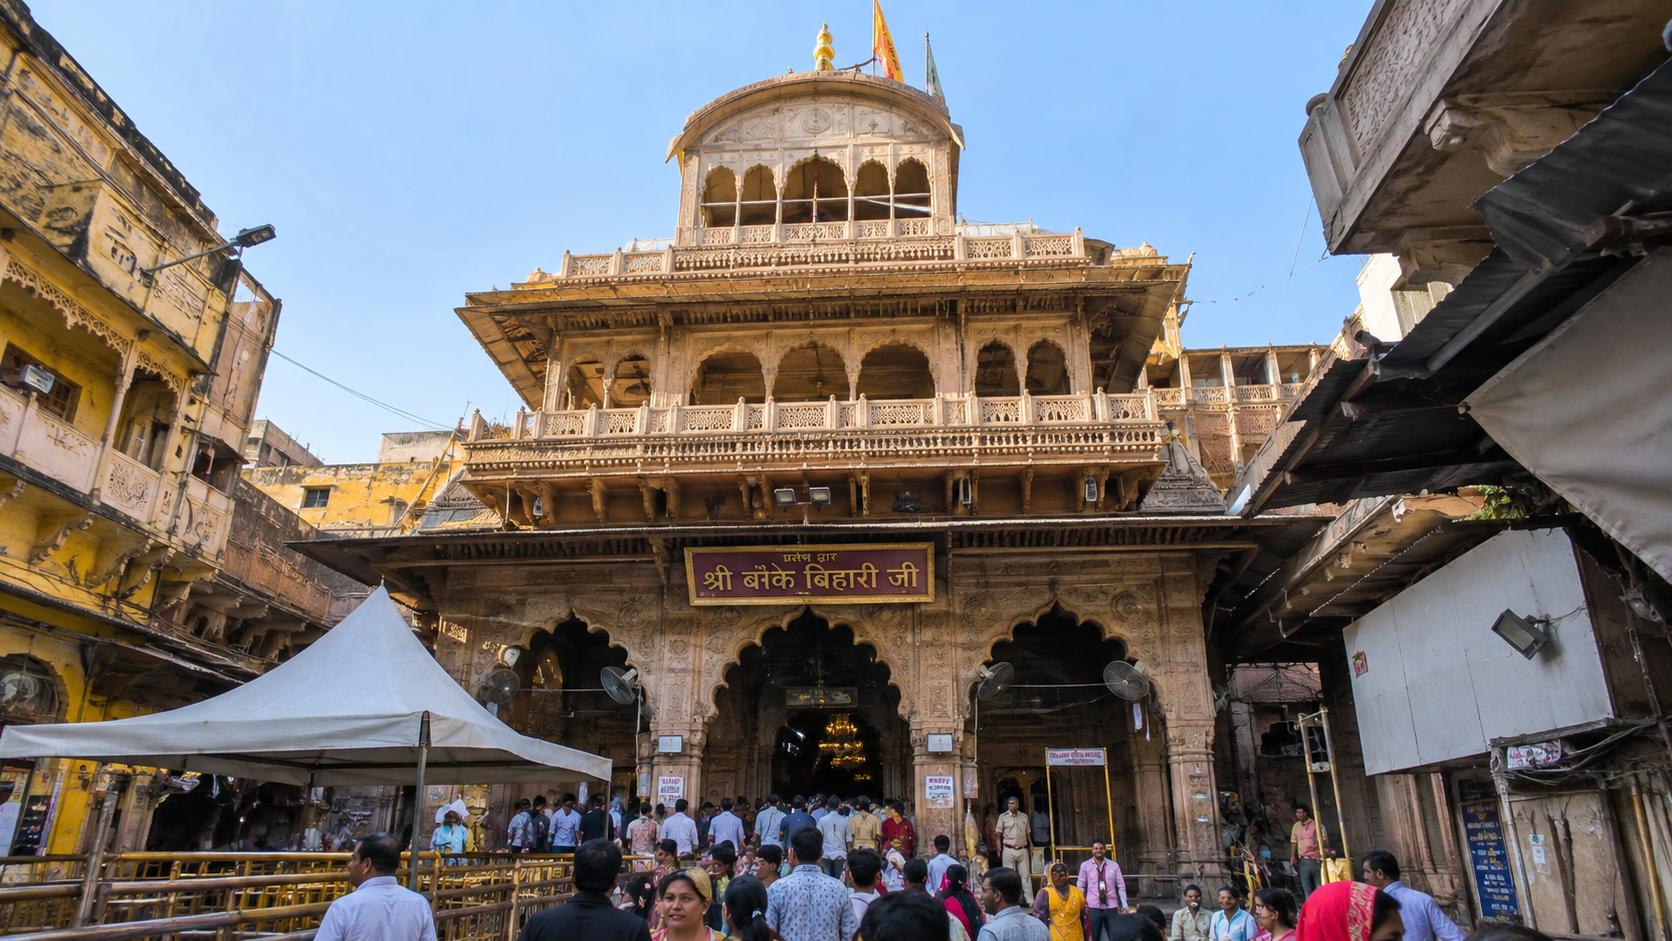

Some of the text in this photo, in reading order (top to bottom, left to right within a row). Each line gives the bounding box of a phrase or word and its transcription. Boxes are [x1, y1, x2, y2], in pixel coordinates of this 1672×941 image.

[702, 564, 733, 591] श्री
[803, 563, 878, 591] बिहारी
[886, 561, 919, 588] जी
